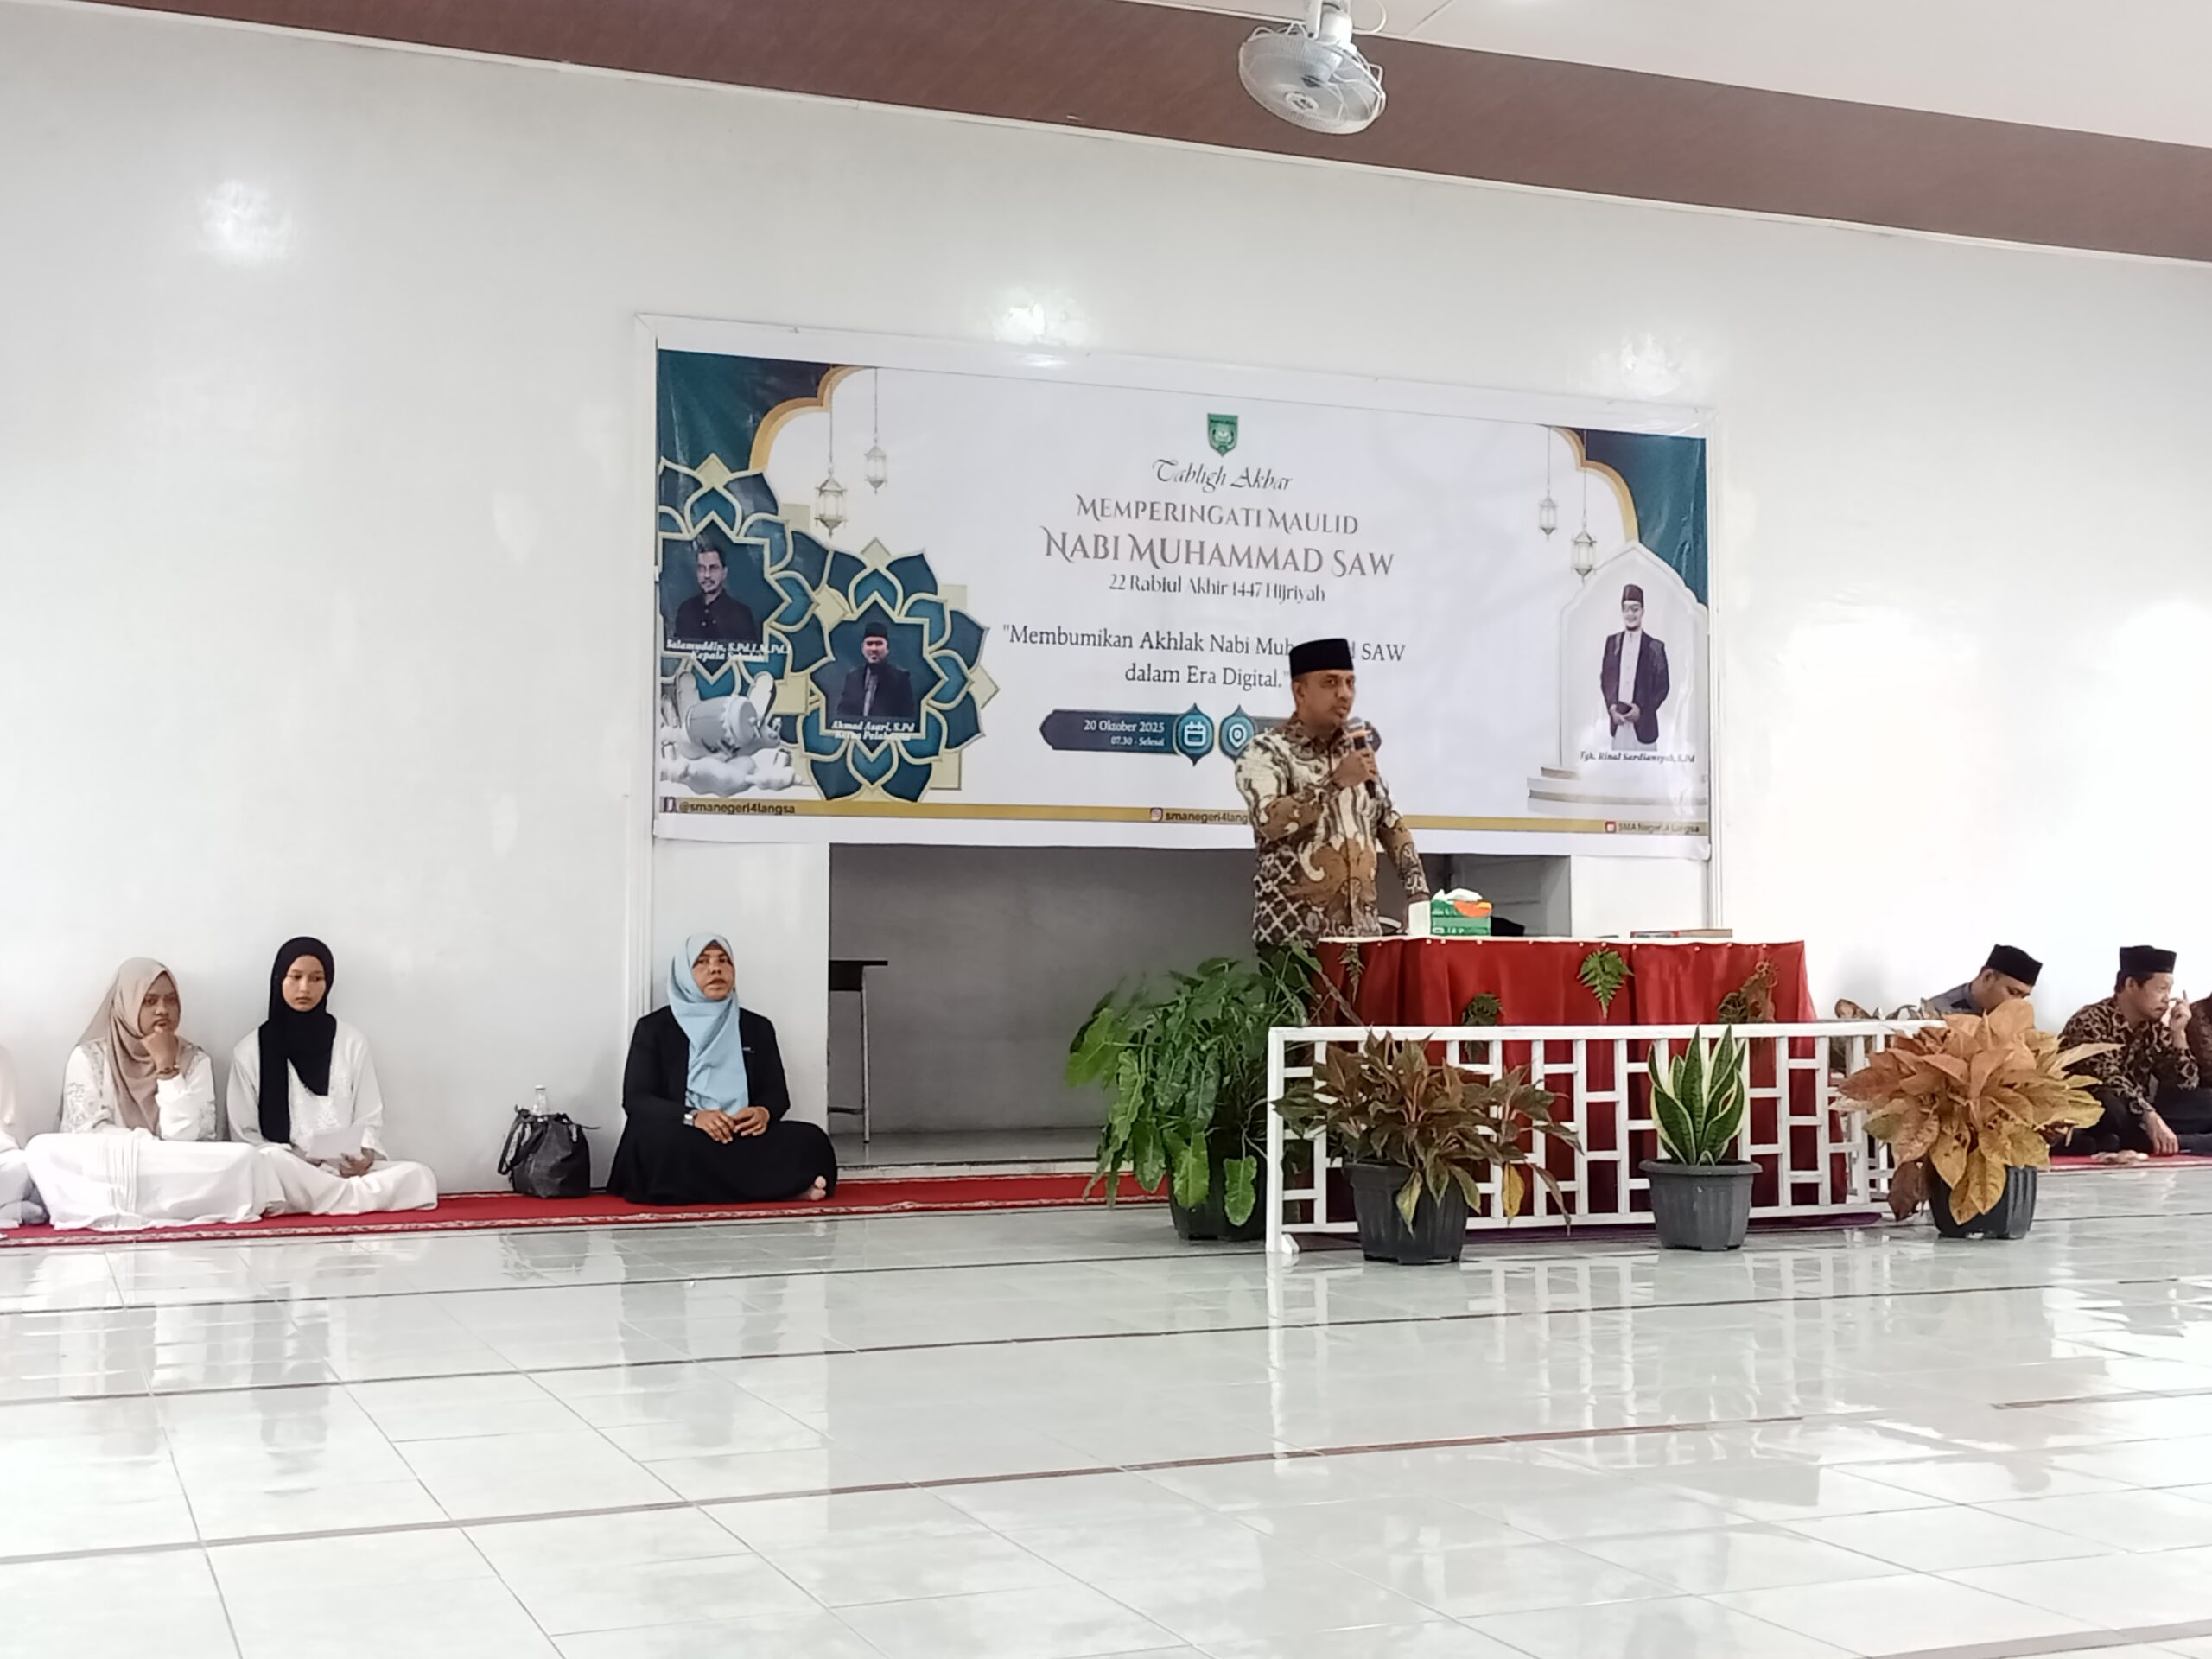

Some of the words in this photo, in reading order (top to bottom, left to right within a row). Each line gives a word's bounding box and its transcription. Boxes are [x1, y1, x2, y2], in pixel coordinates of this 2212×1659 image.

[1152, 459, 1226, 493] Tabligh
[1230, 467, 1293, 491] Akbar
[1076, 494, 1262, 527] MEMPERINGATI
[1268, 507, 1358, 534] MAULID
[1039, 526, 1119, 563] NABI
[1128, 533, 1323, 573] MUHAMMAD
[1109, 574, 1126, 590] 22
[1129, 575, 1181, 594] Rabiul
[1188, 577, 1228, 596] Akhir
[1232, 581, 1261, 597] 1447
[1265, 582, 1325, 605] Hijriyah
[1002, 624, 1133, 649] "Membumikan
[1139, 631, 1204, 652] Akhlak
[1210, 634, 1249, 654] Nabi
[1362, 643, 1406, 661] SAW
[1125, 663, 1180, 683] dalam
[1186, 666, 1216, 685] Era
[1084, 719, 1096, 731] 20
[1098, 719, 1137, 732] Oktober
[1139, 721, 1165, 733] 2025
[679, 802, 796, 815] @smanegeri4langsa
